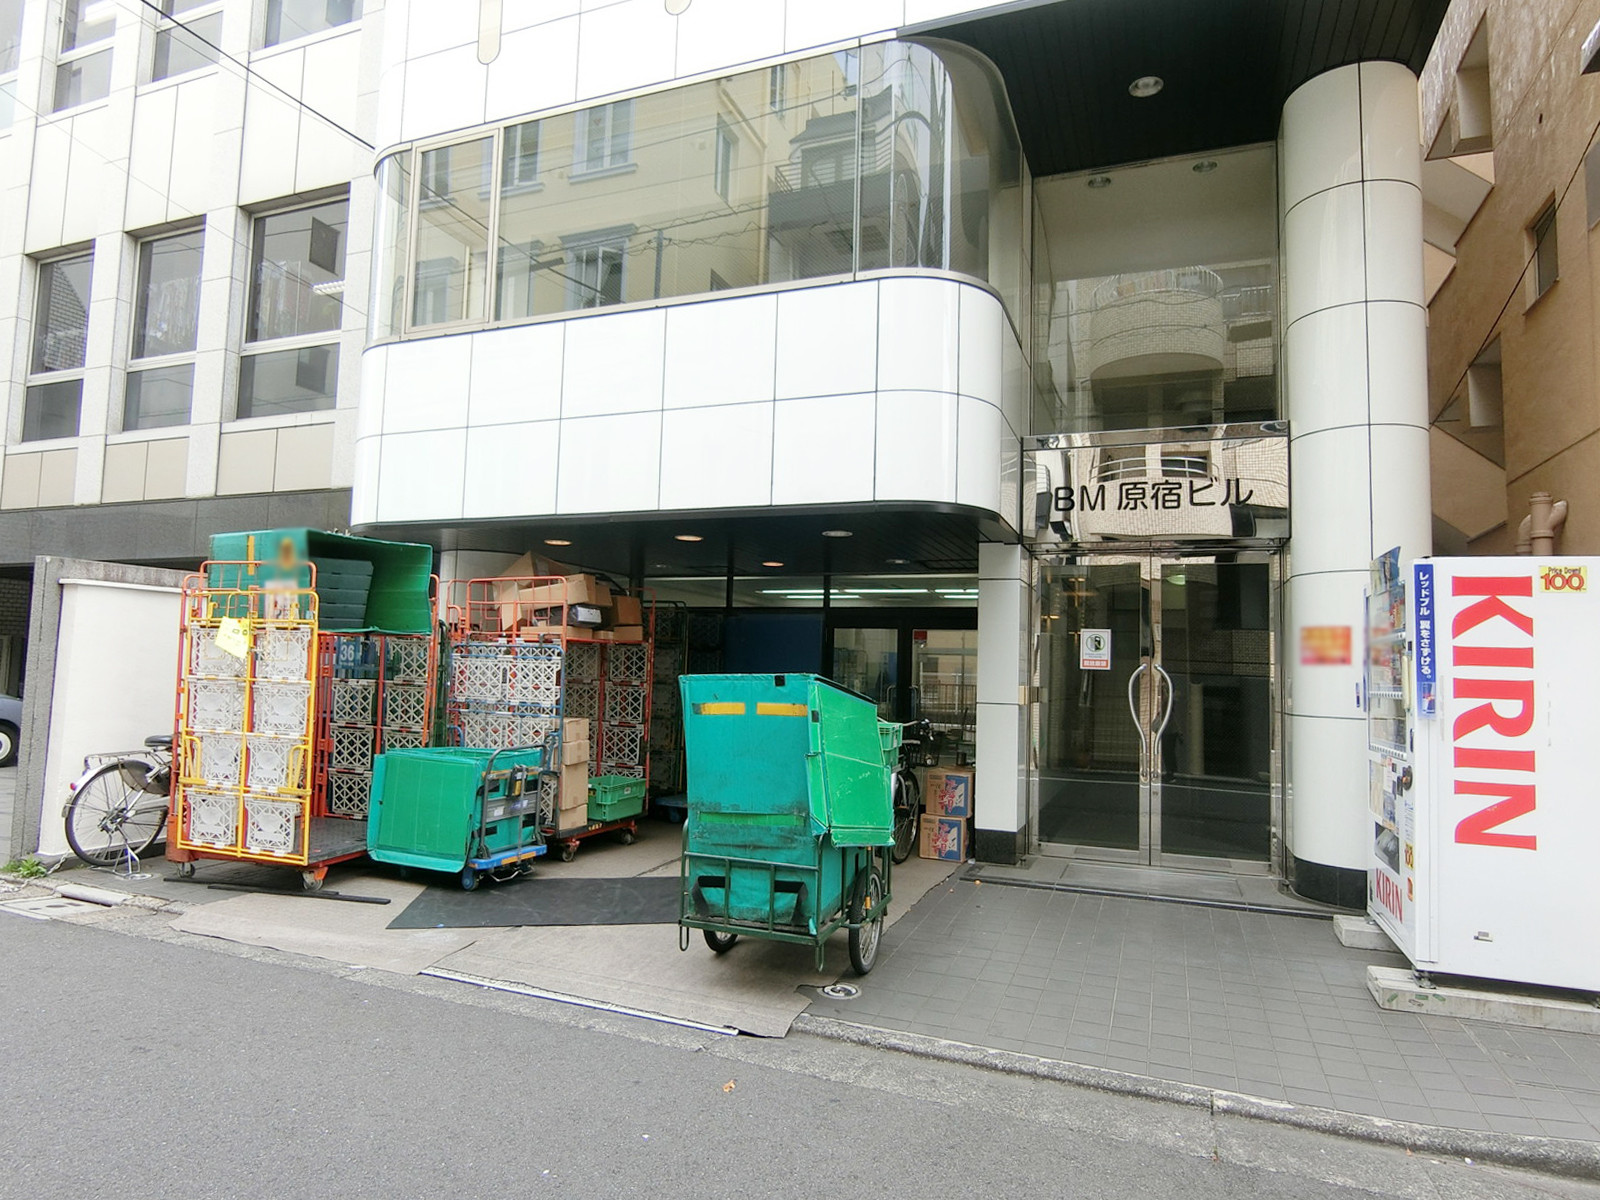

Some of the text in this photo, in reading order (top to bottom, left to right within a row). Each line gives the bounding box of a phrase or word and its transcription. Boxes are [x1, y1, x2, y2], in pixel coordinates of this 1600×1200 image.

[1053, 478, 1253, 511] BM 原宿ビル
[1540, 573, 1585, 591] 100
[1548, 567, 1562, 575] Price
[340, 644, 355, 661] 36
[1452, 576, 1537, 850] KIRIN
[1375, 868, 1403, 924] KIRIN
